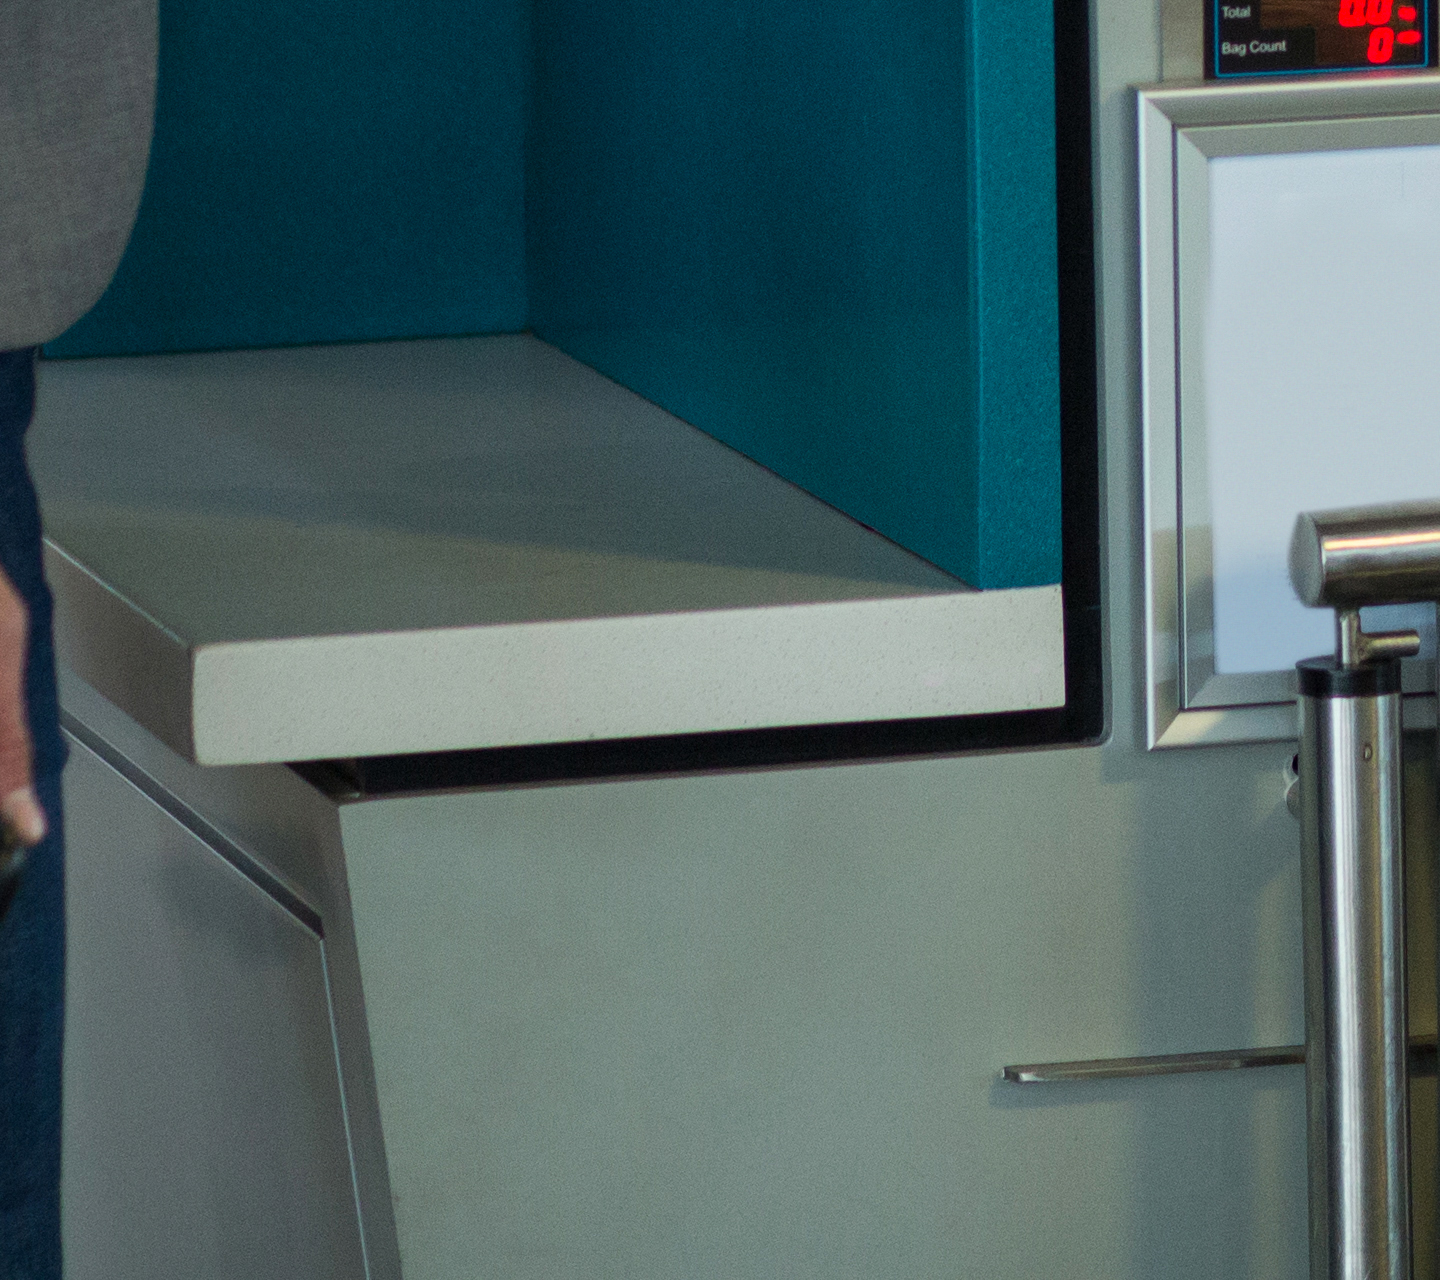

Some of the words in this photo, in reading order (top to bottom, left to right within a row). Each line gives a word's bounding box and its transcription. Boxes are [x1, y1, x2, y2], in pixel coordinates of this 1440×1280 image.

[1222, 5, 1251, 19] Total
[1221, 41, 1247, 57] Bag
[1249, 40, 1286, 53] Count
